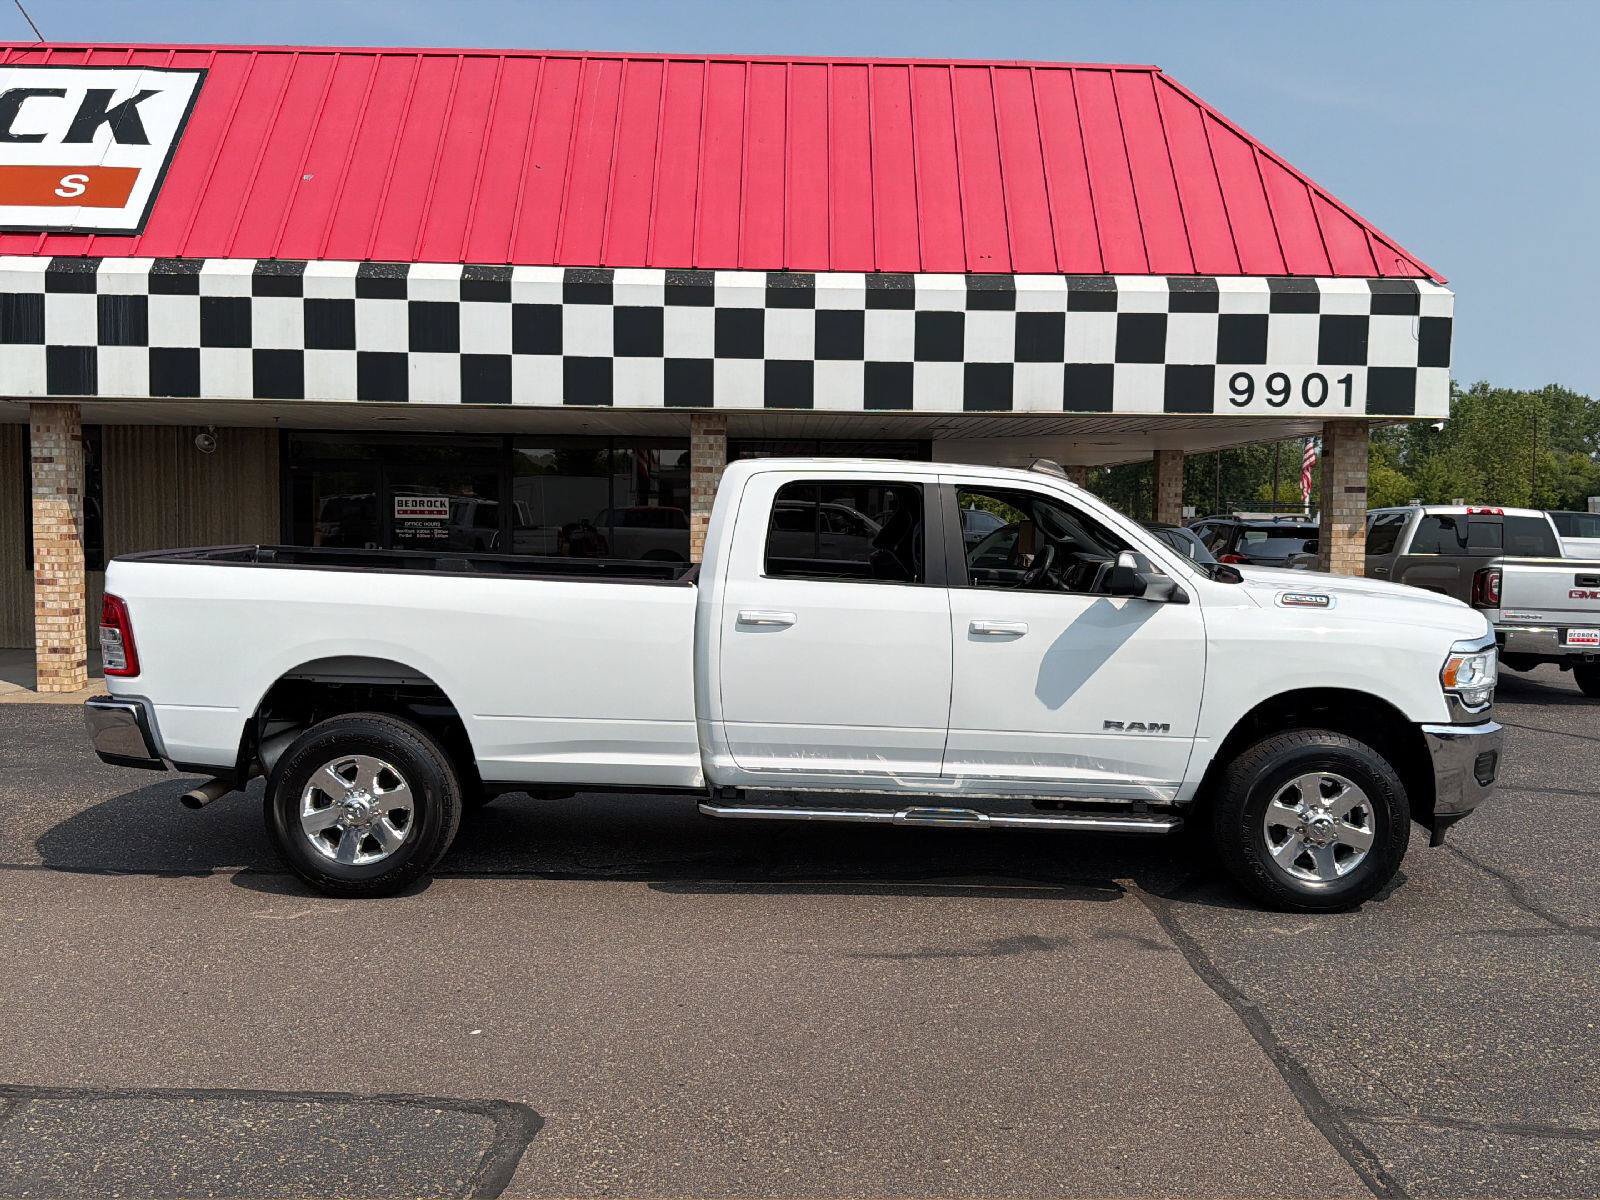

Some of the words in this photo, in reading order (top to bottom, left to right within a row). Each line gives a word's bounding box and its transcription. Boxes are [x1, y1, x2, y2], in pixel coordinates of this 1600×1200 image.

[0, 88, 165, 145] CK
[54, 174, 90, 198] S
[1229, 372, 1353, 408] 9901
[397, 499, 447, 508] BEDROCK
[1103, 720, 1170, 733] RAM
